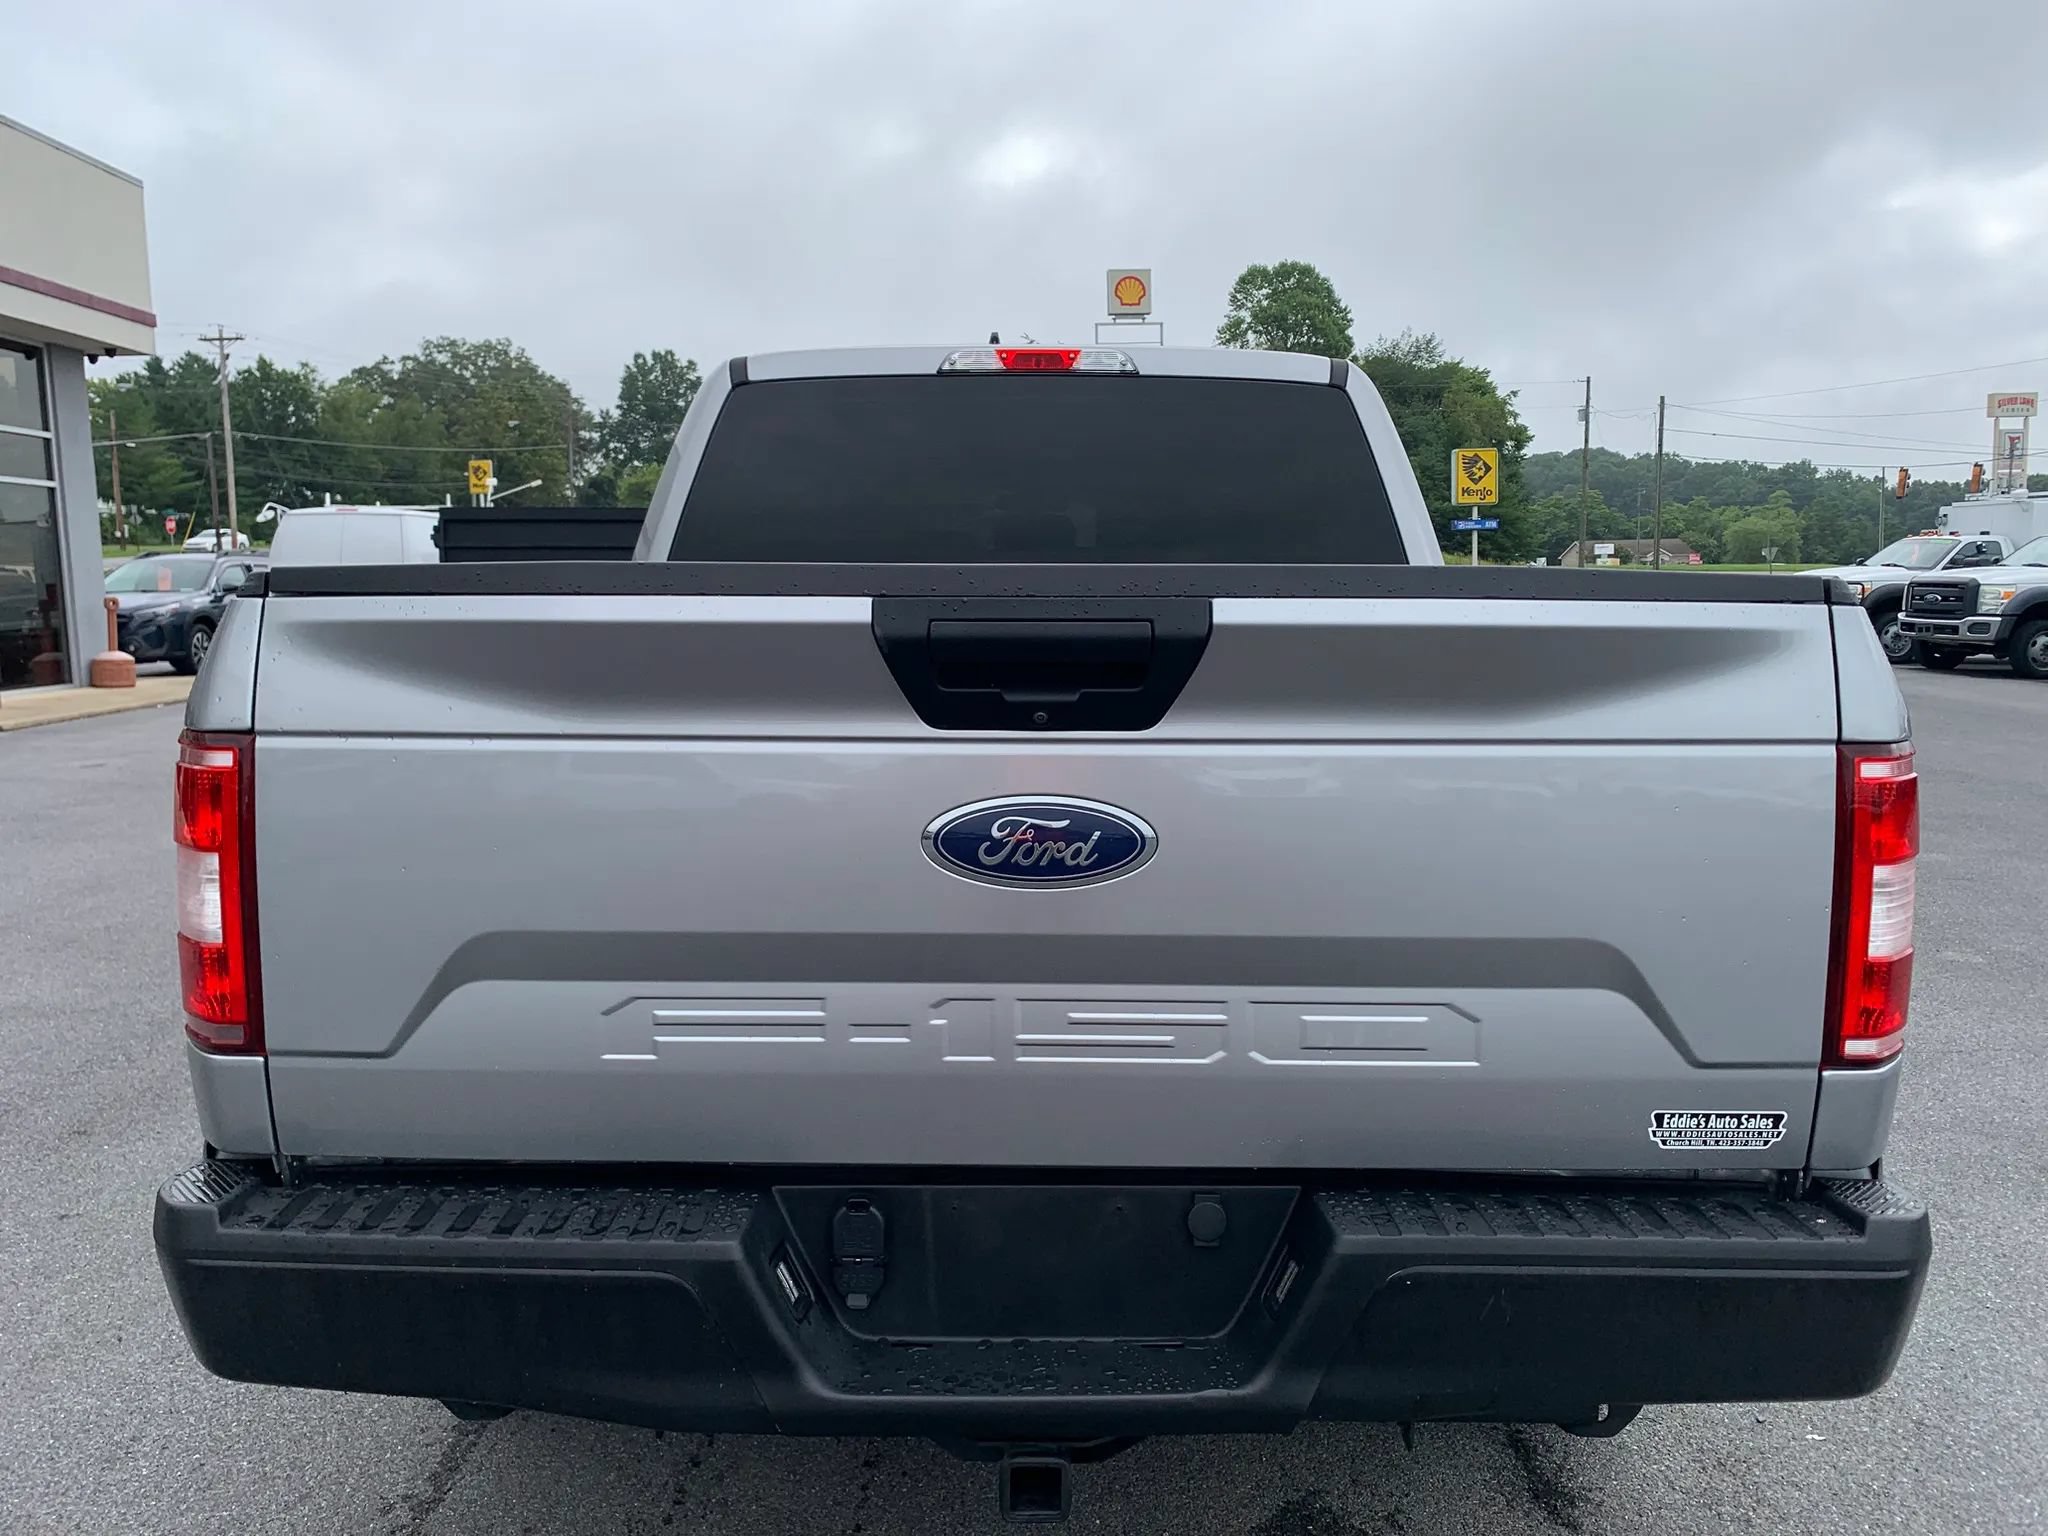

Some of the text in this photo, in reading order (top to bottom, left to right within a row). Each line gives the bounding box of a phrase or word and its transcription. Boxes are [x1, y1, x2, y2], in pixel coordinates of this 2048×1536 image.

[977, 815, 1102, 867] Ford
[600, 996, 1482, 1068] F-150
[1655, 1130, 1778, 1138] WWW.EDDIESAUTOSALES.NET
[1662, 1113, 1774, 1129] Eddie's Auto Sales
